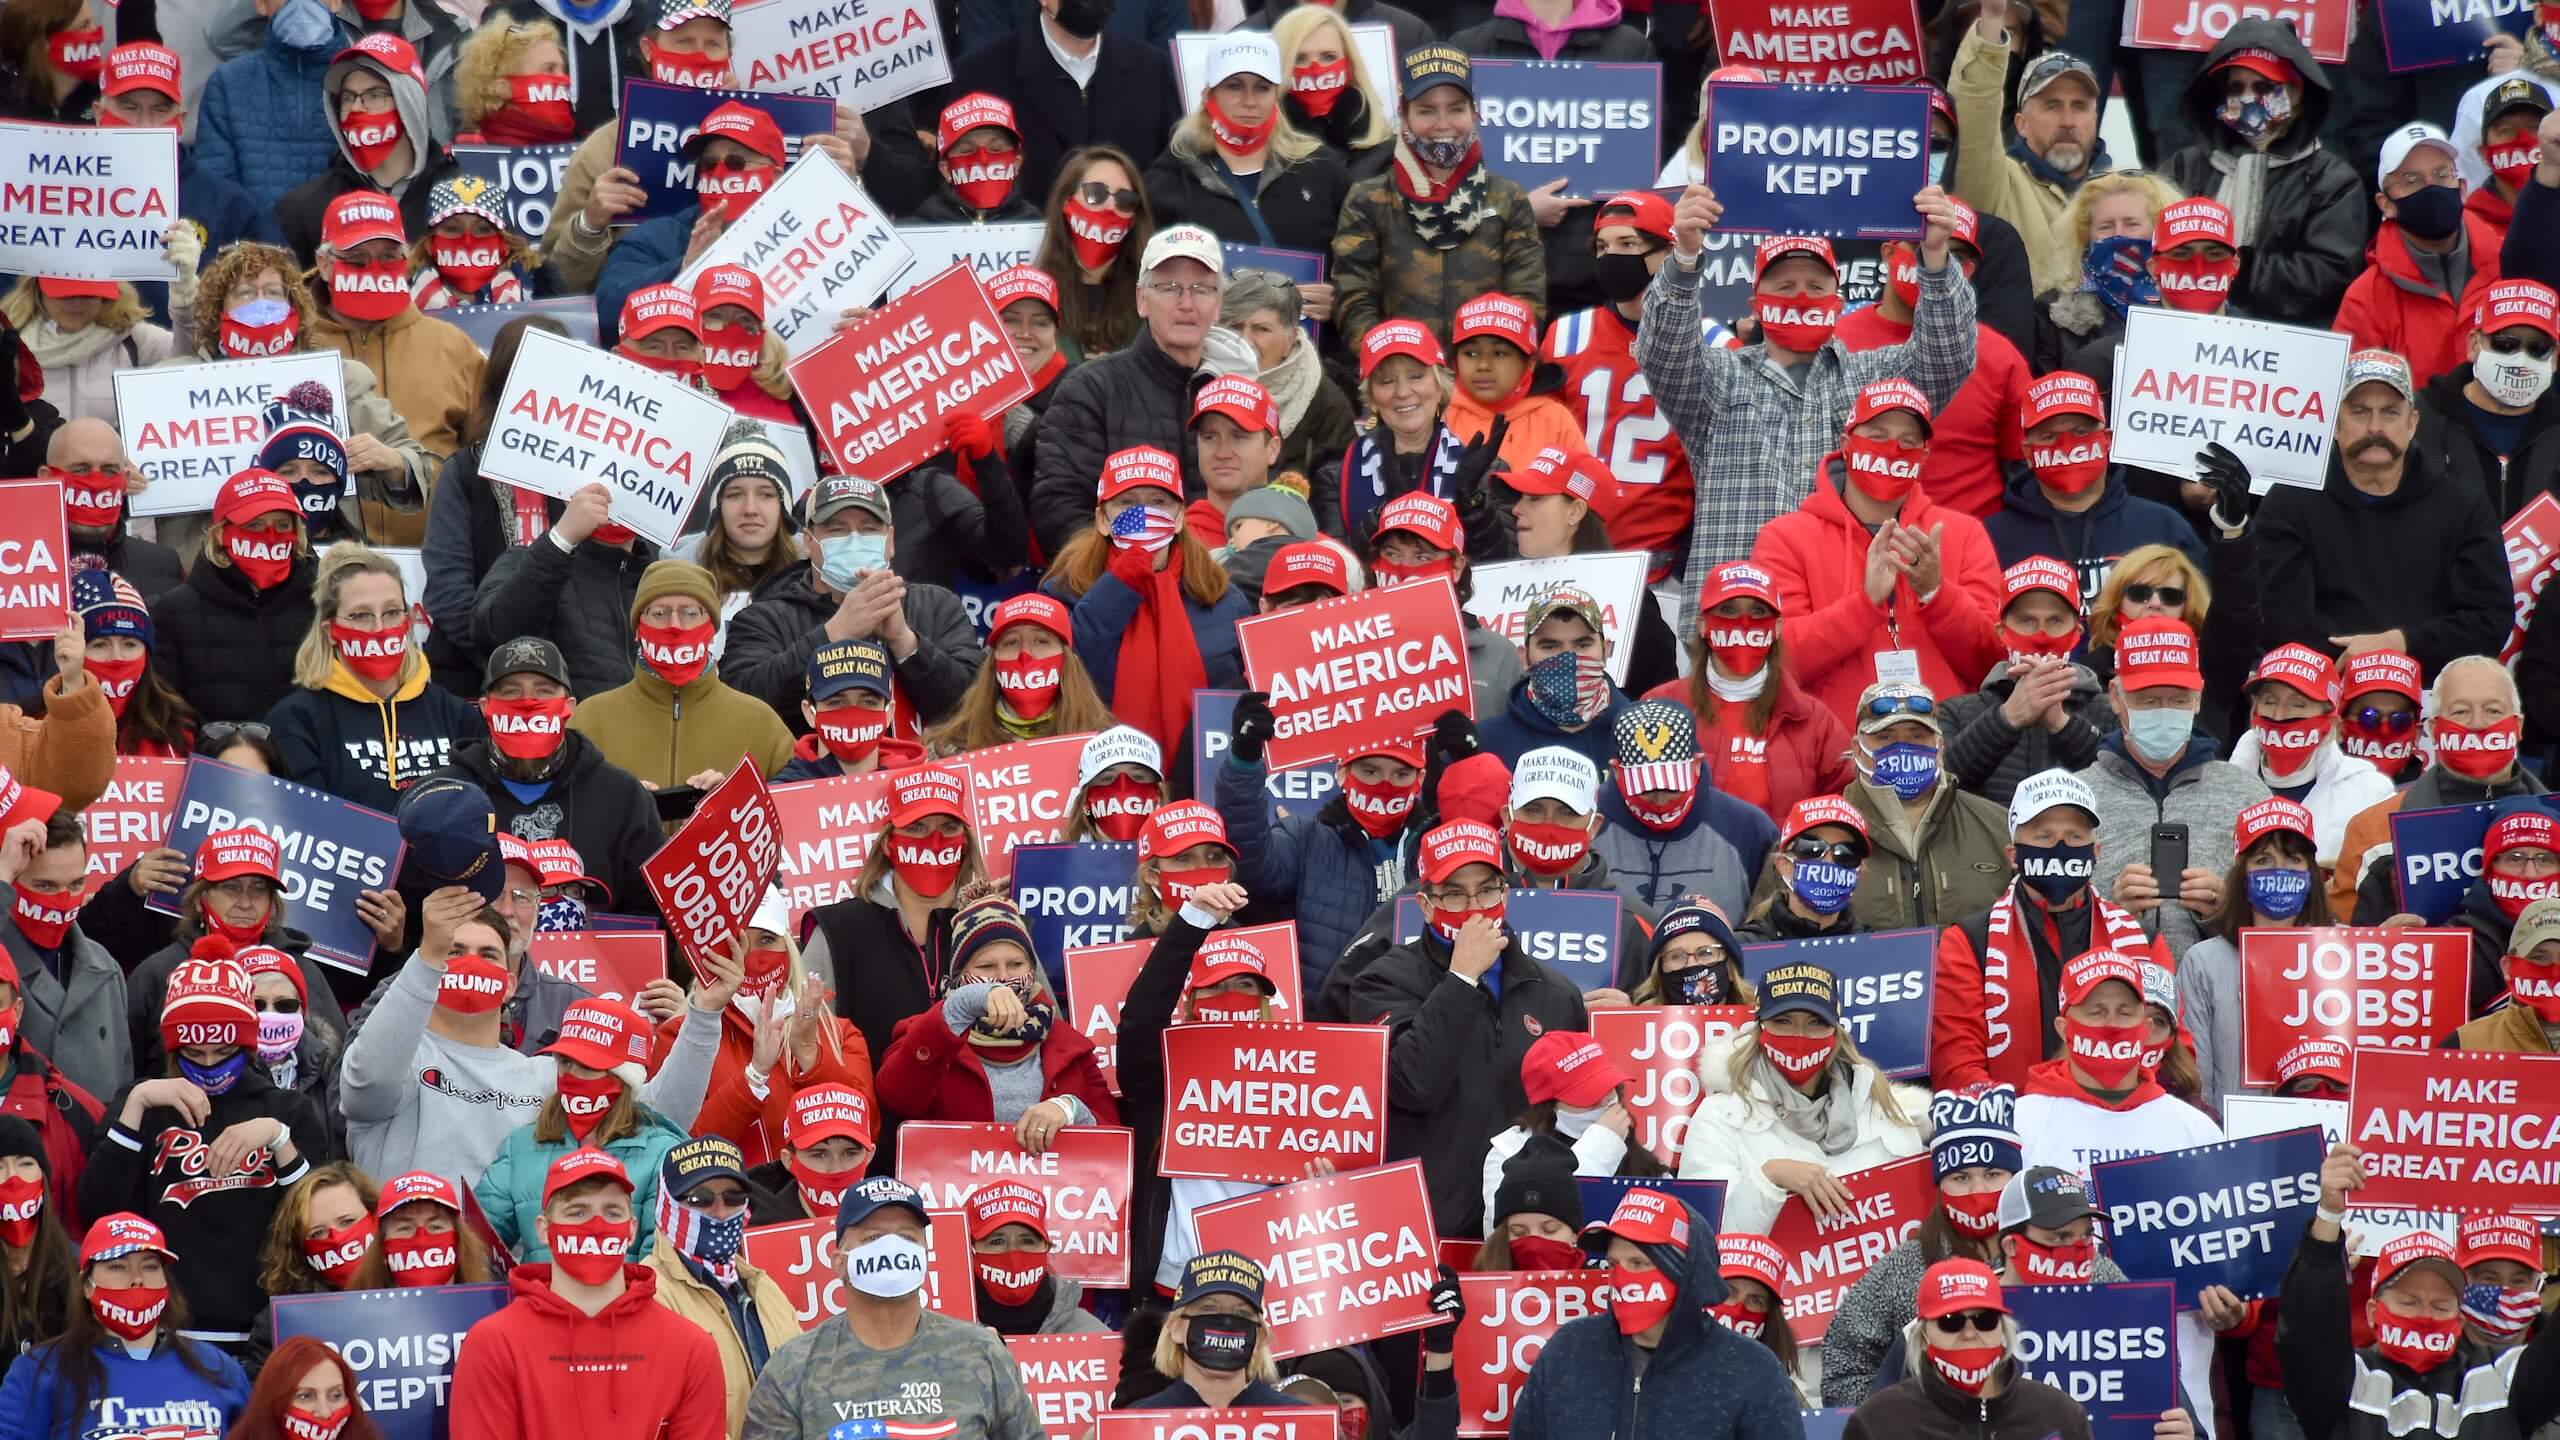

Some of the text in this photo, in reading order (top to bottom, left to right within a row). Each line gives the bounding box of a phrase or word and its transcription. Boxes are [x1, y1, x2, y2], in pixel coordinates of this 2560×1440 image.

[789, 0, 868, 39] MAKE
[1769, 6, 1850, 28] MAKE
[749, 7, 928, 88] AMERICA
[1727, 27, 1910, 63] AMERICA
[853, 40, 934, 88] AGAIN
[1406, 49, 1471, 68] MAKE AMERICA
[1411, 63, 1467, 80] GREAT AGAIN
[1478, 101, 1650, 130] ROMISES
[1503, 135, 1603, 164] KEPT
[1716, 124, 1920, 160] PROMISES
[29, 153, 112, 176] MAKE
[952, 164, 1015, 184] MAGA
[1765, 164, 1868, 196] KEPT
[2, 183, 167, 219] MERICA
[338, 206, 395, 223] TRUMP
[2164, 205, 2228, 226] MAKE AMERICA
[0, 226, 169, 249] REAT AGAIN
[739, 209, 802, 268] MAKE
[2170, 220, 2225, 236] GREAT AGAIN
[437, 249, 501, 267] MAGA
[763, 201, 869, 309] ERICA
[822, 225, 890, 298] AGAIN
[335, 274, 409, 292] MAGA
[2160, 272, 2228, 292] MAGA
[1460, 300, 1527, 322] MAKE AMERICA
[1762, 304, 1836, 327] MAGA
[1463, 315, 1521, 334] GREAT AGAIN
[228, 327, 296, 357] MAGA
[854, 314, 934, 376] MAKE
[2194, 341, 2280, 374] MAKE
[829, 319, 1000, 439] AMERICA
[2494, 363, 2540, 391] Trump
[188, 384, 273, 410] MAKE
[579, 373, 664, 423] MAKE
[2130, 367, 2326, 424] AMERICA
[843, 351, 1016, 466] GREAT AGAIN
[510, 388, 693, 487] AMERICA
[1579, 367, 1673, 485] 12
[2127, 409, 2322, 458] GREAT AGAIN
[298, 440, 344, 477] 2020
[1109, 451, 1175, 472] MAKE AMERICA
[1851, 452, 1920, 480] MAGA
[2034, 441, 2102, 469] MAGA
[139, 455, 236, 482] GREAT
[501, 427, 685, 516] GREAT AGAIN
[1114, 466, 1173, 483] GREAT AGAIN
[1718, 568, 1770, 587] Trump
[1310, 613, 1395, 653] MAKE
[1710, 629, 1773, 647] MAGA
[2123, 633, 2191, 649] MAKE AMERICA
[2128, 650, 2189, 665] GREAT AGAIN
[1268, 634, 1458, 708] AMERICA
[1273, 674, 1465, 740] GREAT AGAIN
[492, 713, 561, 735] MAGA
[820, 723, 883, 744] TRUMP
[2348, 736, 2412, 759] MAGA
[2439, 731, 2517, 751] MAGA
[1521, 756, 1592, 778] MAKE AMERICA
[1877, 758, 1936, 775] TRUMP
[1525, 770, 1586, 791] GREAT AGAIN
[1091, 795, 1156, 817] MAGA
[2500, 816, 2552, 832] TRUMP
[897, 845, 961, 865] MAGA
[1514, 833, 1582, 860] TRUMP
[698, 829, 751, 927] JOBS!
[1795, 862, 1856, 887] TRUMP
[2024, 857, 2092, 878] MAGA
[2255, 875, 2306, 893] TRUMP
[663, 863, 732, 947] JOBS!
[1663, 915, 1700, 934] TRUMP
[2283, 942, 2433, 981] JOBS!
[2283, 989, 2432, 1028] JOBS!
[176, 1022, 237, 1045] 2020
[257, 1023, 296, 1041] RUMP
[1764, 1044, 1831, 1071] TRUMP
[2072, 1034, 2140, 1059] MAGA
[1234, 1048, 1316, 1074] MAKE
[1177, 1078, 1374, 1120] AMERICA
[2426, 1077, 2518, 1105] MAKE
[1175, 1122, 1374, 1153] GREAT AGAIN
[970, 1150, 1060, 1175] MAKE
[1938, 1143, 1994, 1171] 2020
[2358, 1152, 2560, 1186] GREAT AGAI
[395, 1175, 445, 1191] Trump
[855, 1179, 916, 1196] TRUMP
[2032, 1174, 2087, 1194] TRUMP
[973, 1185, 1044, 1208] MAKE AMERICA
[2111, 1171, 2321, 1237] PROMISES
[980, 1202, 1040, 1221] GREAT AGAIN
[1266, 1202, 1360, 1246] MAKE
[107, 1218, 156, 1236] Trump
[123, 1230, 150, 1241] 2020
[2464, 1217, 2536, 1236] MAKE AMERICA
[309, 1232, 374, 1271] MAGA
[556, 1235, 628, 1256] MAGA
[2170, 1221, 2276, 1268] KEPT
[2469, 1234, 2531, 1249] GREAT AGAIN
[388, 1246, 456, 1271] MAGA
[856, 1252, 922, 1276] MAGA
[1260, 1225, 1426, 1290] MERICA
[980, 1264, 1045, 1289] TRUMP
[1938, 1273, 1988, 1288] Trump
[1338, 1267, 1433, 1312] AGAIN
[100, 1299, 166, 1326] TRUMP
[1203, 1329, 1246, 1350] TRUMP
[2014, 1326, 2167, 1361] OMISES
[2381, 1323, 2455, 1351] MAGA
[1022, 1359, 1108, 1384] MAKE
[900, 1382, 941, 1398] 2020
[90, 1396, 221, 1430] Trump
[833, 1398, 944, 1422] VETERANS
